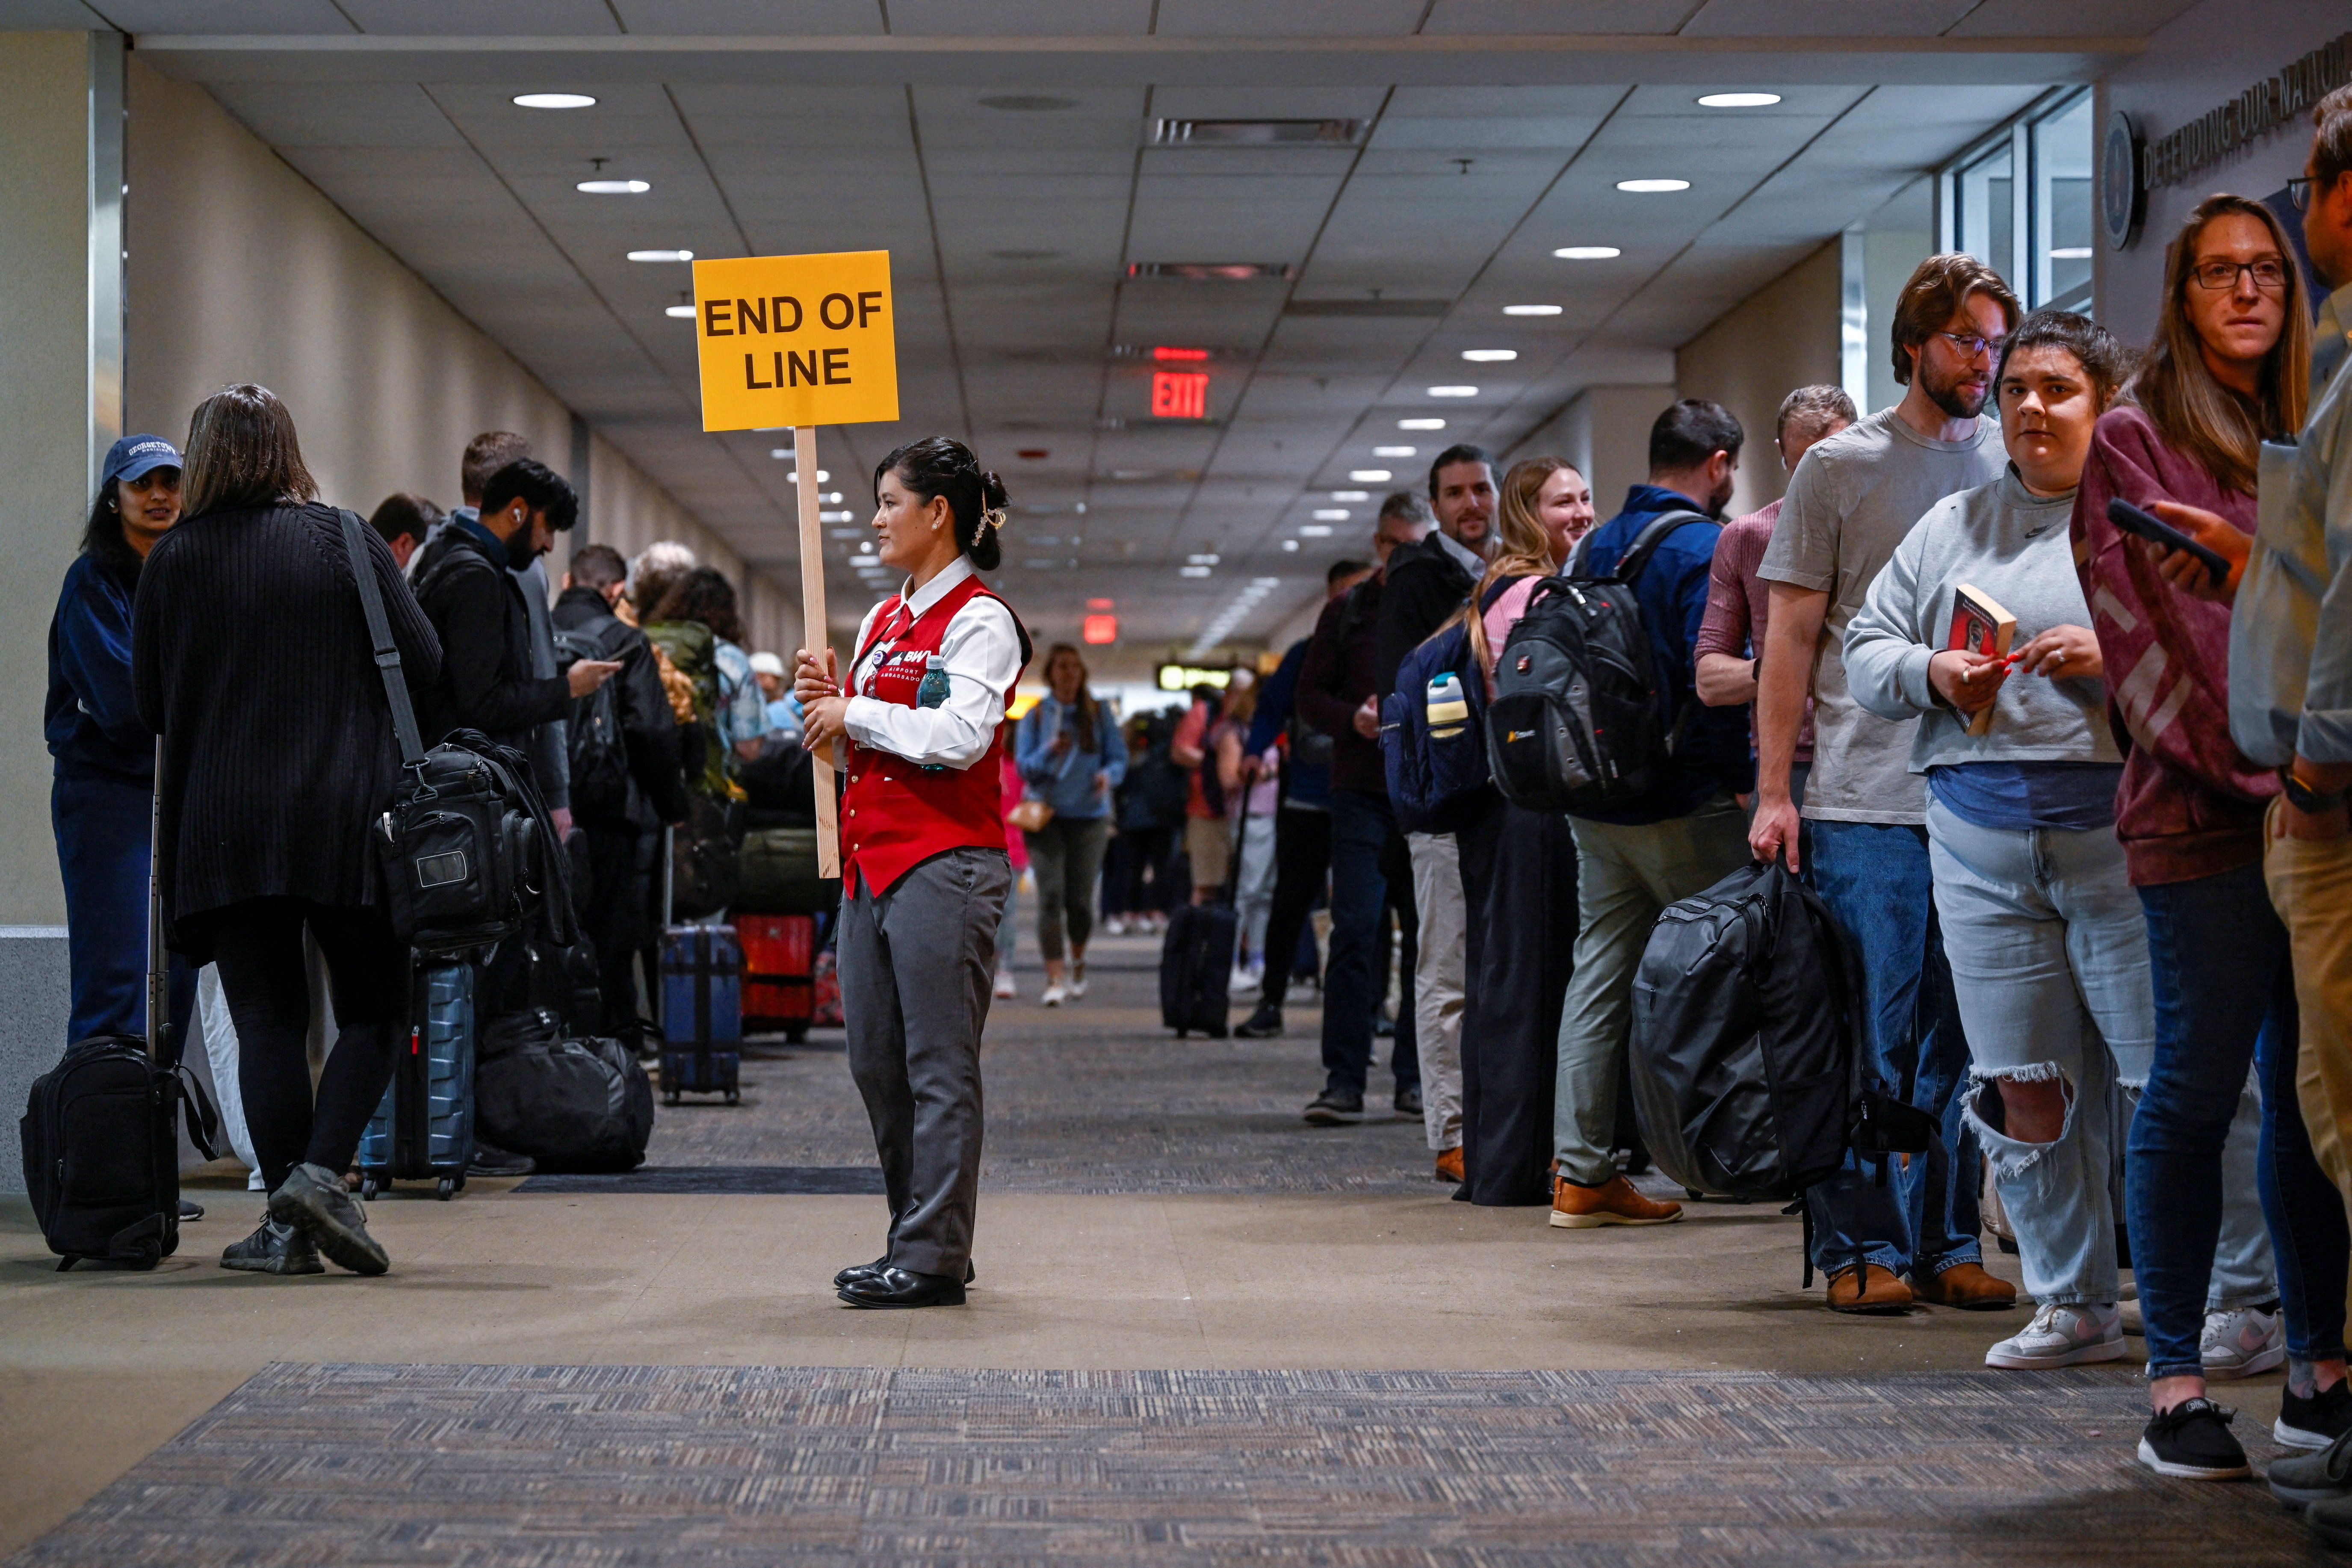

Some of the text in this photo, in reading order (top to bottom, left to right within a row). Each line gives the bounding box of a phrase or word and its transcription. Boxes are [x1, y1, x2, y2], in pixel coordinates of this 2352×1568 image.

[2143, 105, 2231, 190] DEFENDING
[2238, 79, 2271, 137] OUR
[704, 291, 882, 337] END OF
[745, 348, 851, 390] LINE
[1152, 372, 1209, 418] EXIT
[881, 673, 920, 682] AMBASSADO
[889, 667, 919, 675] AIRPORT
